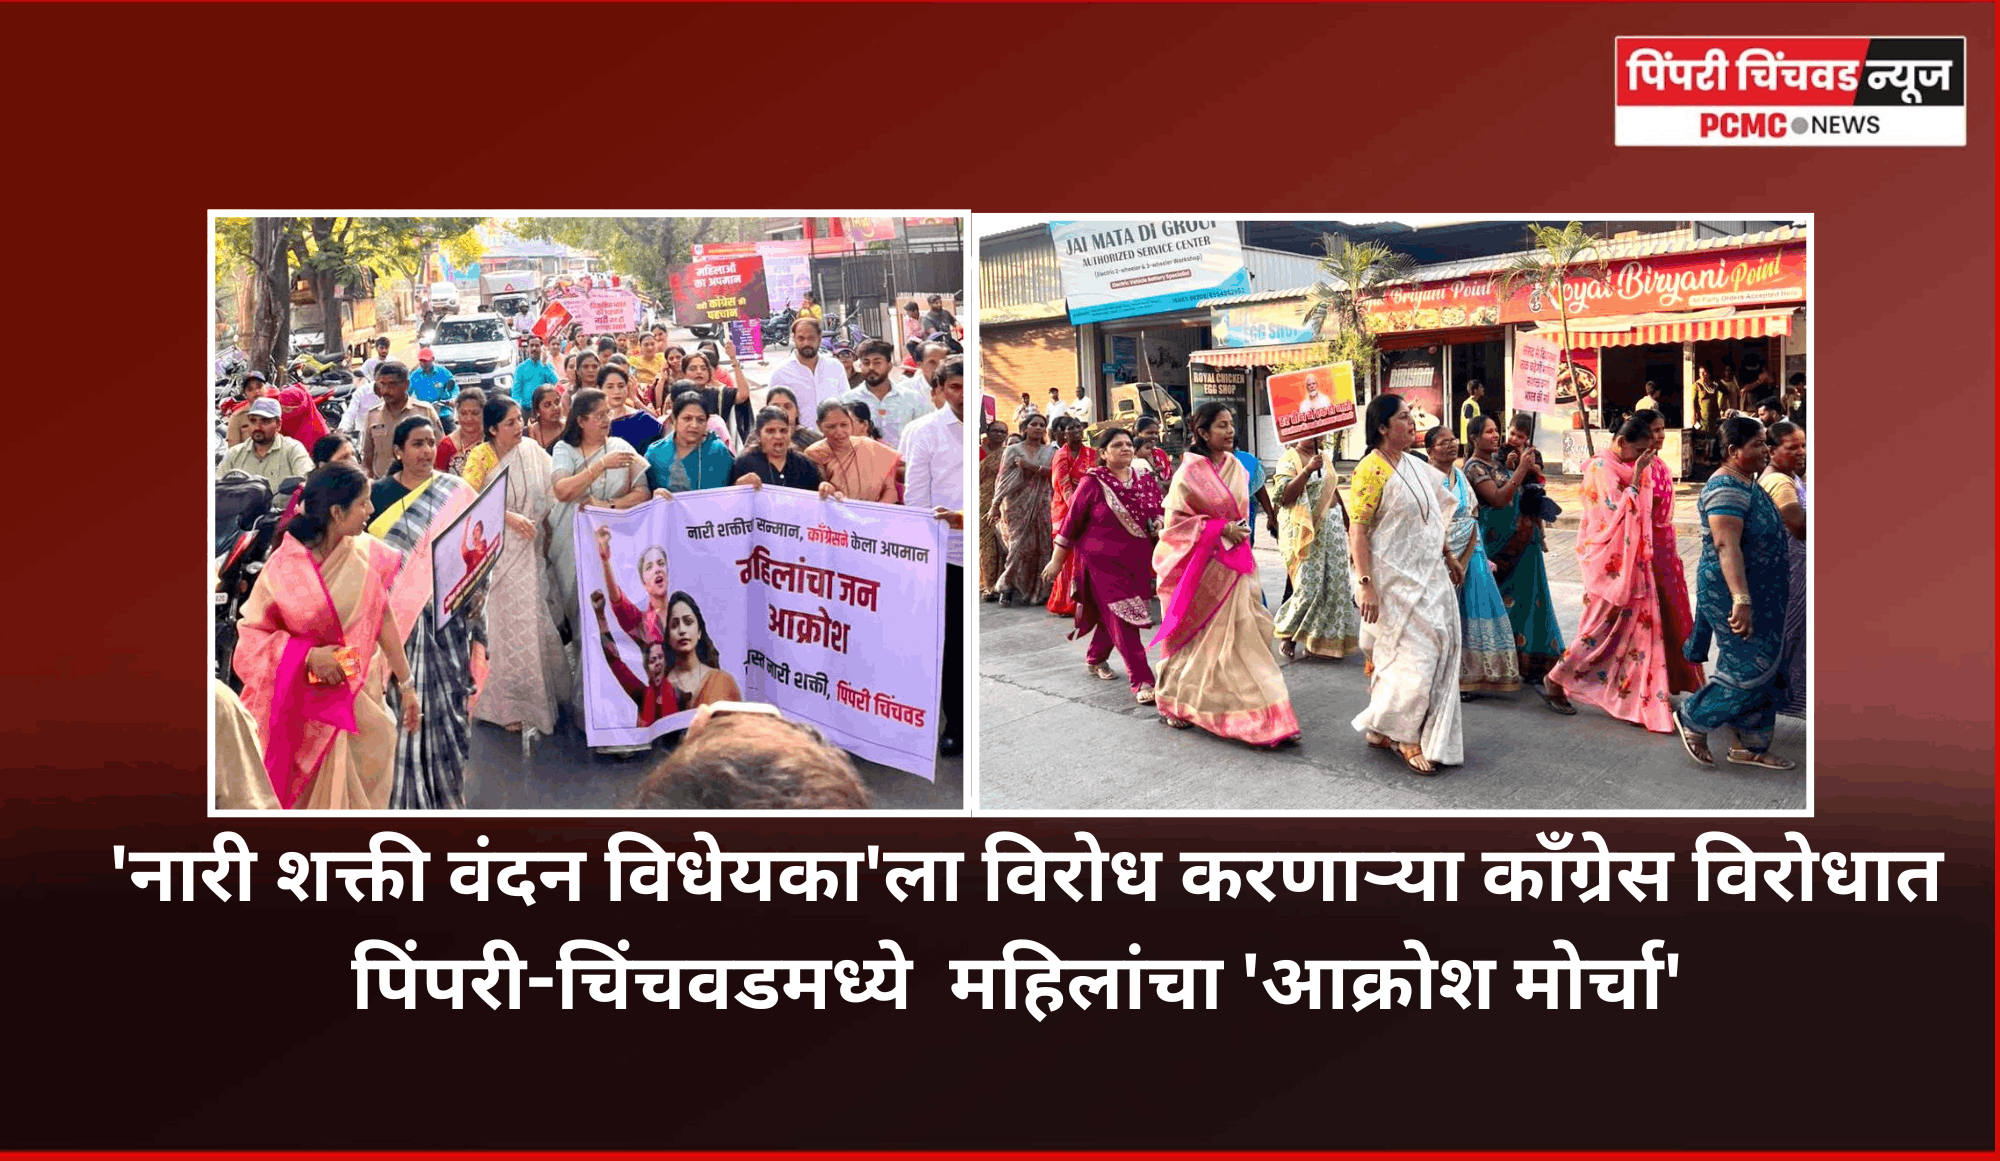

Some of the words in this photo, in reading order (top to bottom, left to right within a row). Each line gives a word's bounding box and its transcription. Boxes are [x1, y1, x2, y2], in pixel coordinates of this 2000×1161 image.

[1066, 236, 1089, 256] JAI
[1091, 229, 1135, 251] MATA
[1082, 250, 1135, 268] AUTHORIZED
[1137, 242, 1174, 258] SERVICE
[1175, 236, 1211, 251] CENTER
[1450, 280, 1492, 298] Point
[1617, 258, 1729, 307] Biryani
[1730, 247, 1784, 292] Point
[1193, 371, 1215, 384] ROYAL
[1216, 372, 1245, 384] CHICKEN
[1203, 384, 1217, 395] EGG
[1218, 384, 1237, 395] SHOP
[686, 520, 715, 540] नारी
[756, 517, 804, 542] सन्मान,
[851, 531, 877, 555] केला
[880, 541, 930, 564] अपमान
[837, 572, 881, 612] जन
[768, 603, 851, 655] आक्रोश
[766, 656, 790, 686] नारी
[794, 671, 830, 700] शक्ती,
[836, 679, 871, 713] पिंपरी
[873, 692, 926, 728] चिंचवड
